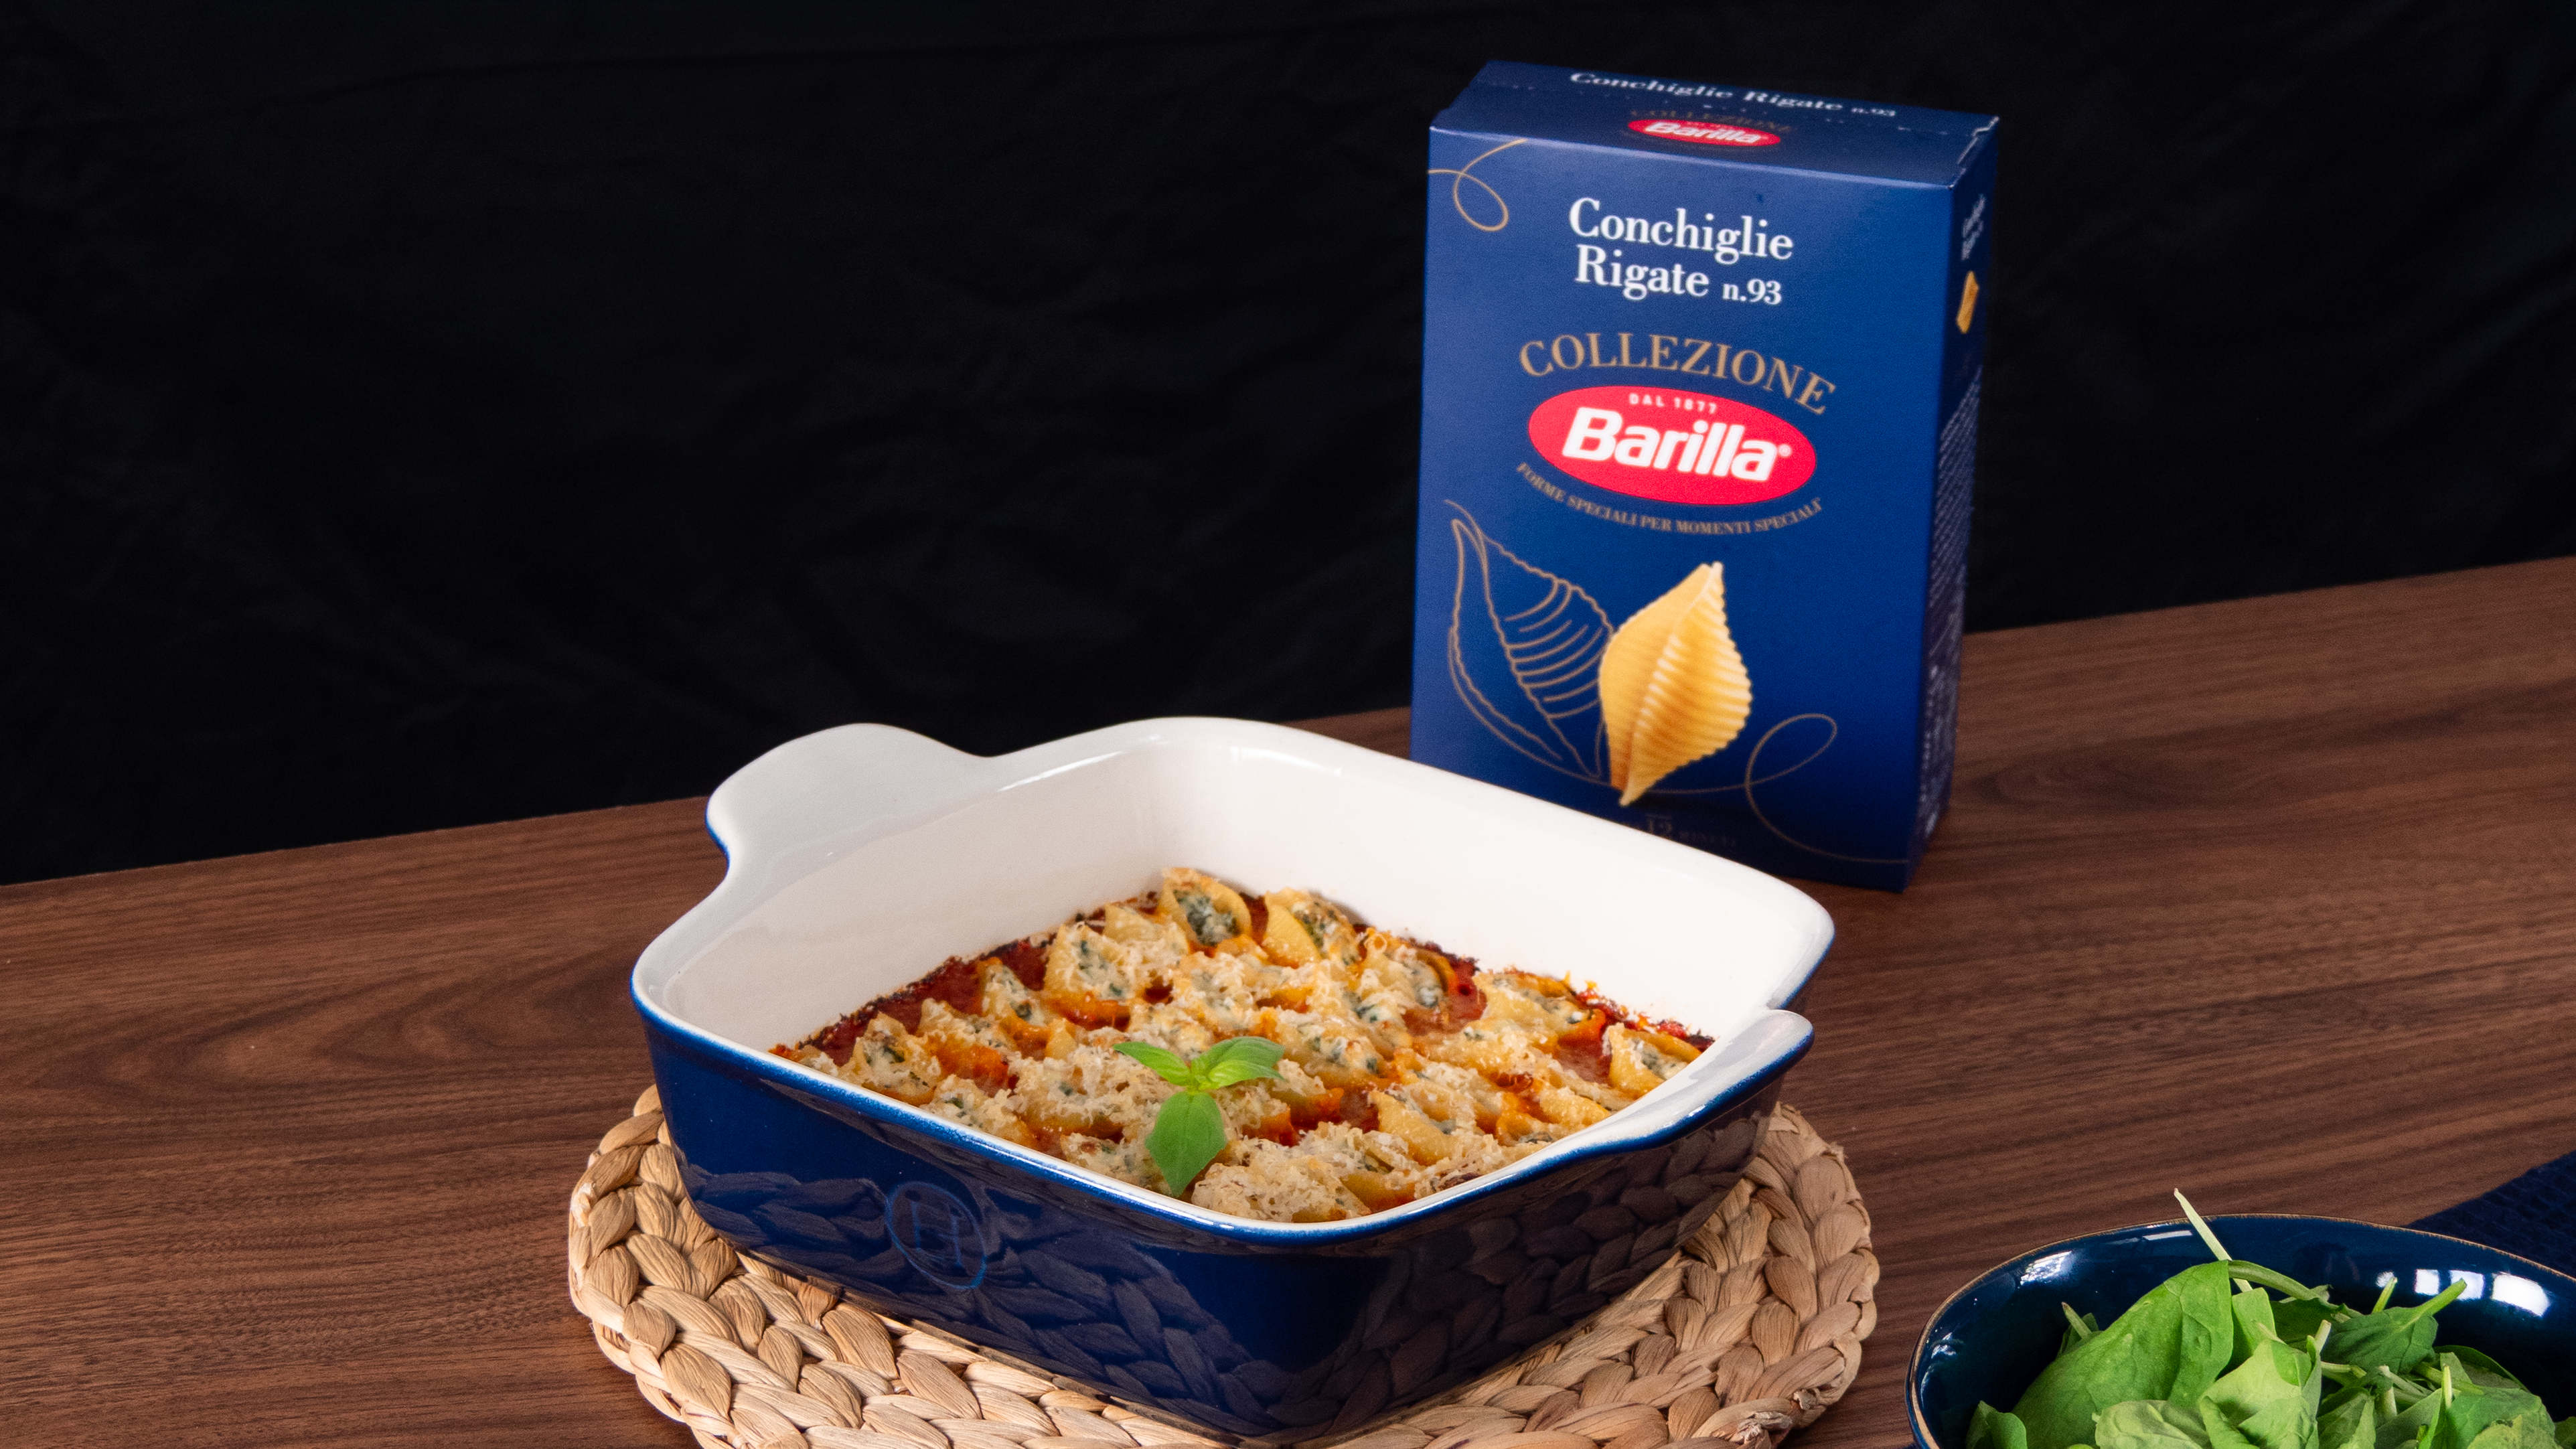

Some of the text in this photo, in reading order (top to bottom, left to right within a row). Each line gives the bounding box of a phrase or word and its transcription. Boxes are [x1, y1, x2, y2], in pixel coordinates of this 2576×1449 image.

[1570, 72, 1896, 117] Conchiglie Rigate n.93
[1569, 198, 1793, 264] Conchiglie
[1576, 244, 1782, 305] Rigate n.93
[1519, 332, 1836, 414] COLLEZIONE
[1628, 392, 1717, 414] DAL 1877
[1516, 462, 1823, 536] FORME SPECIALI PER MOMENTI SPECIALI
